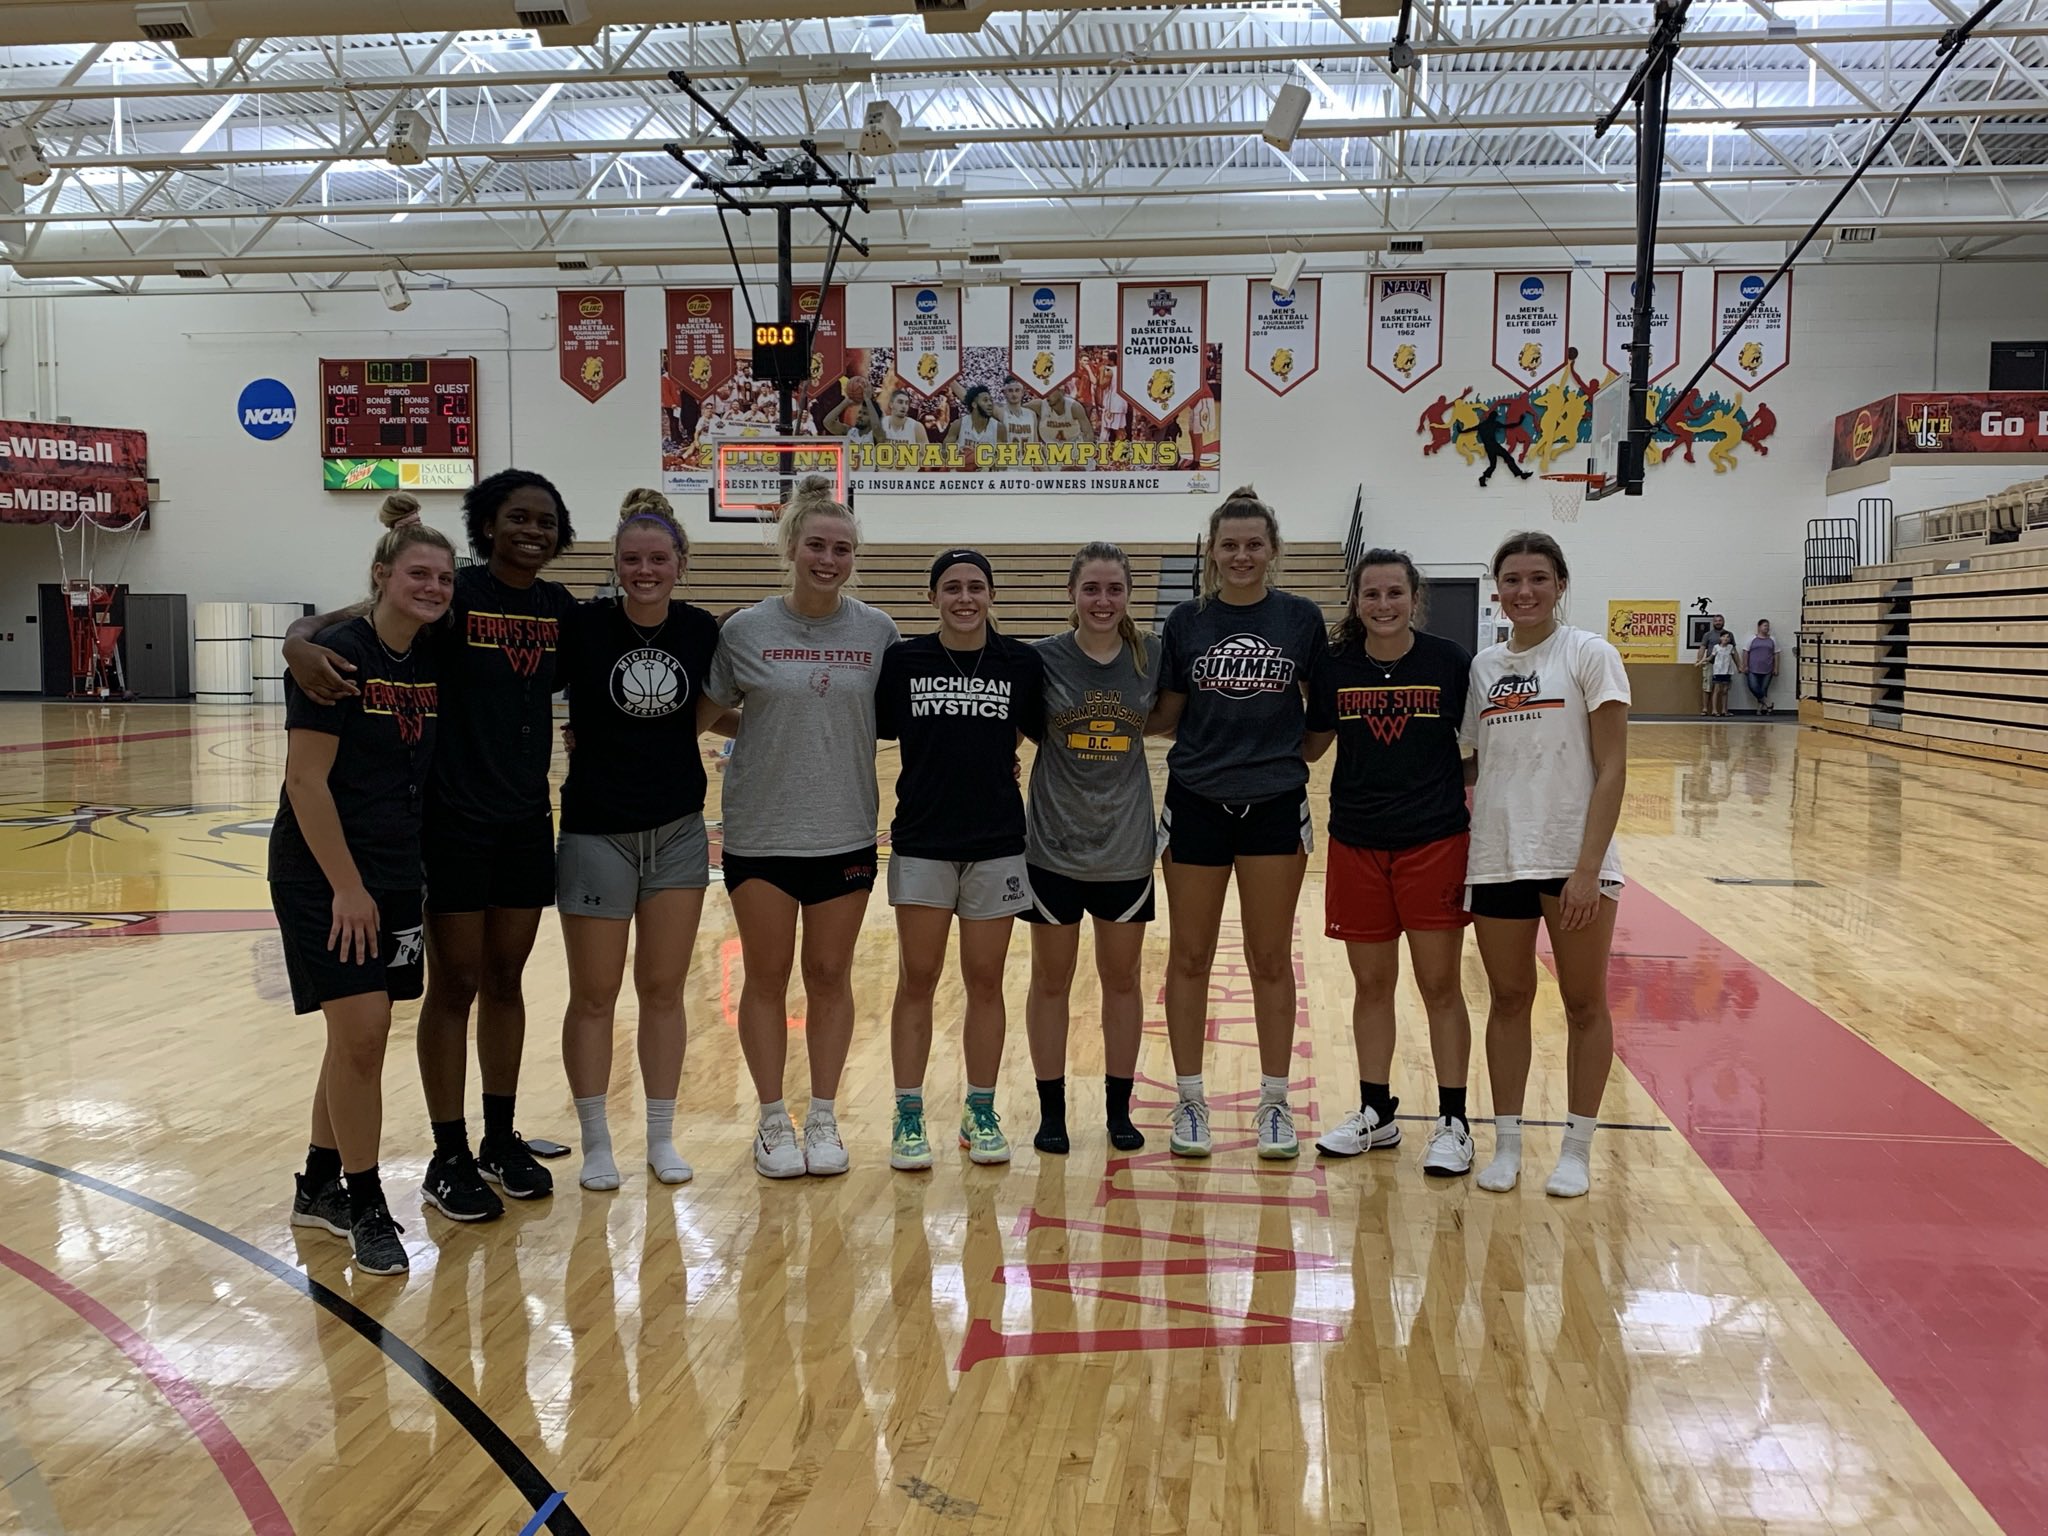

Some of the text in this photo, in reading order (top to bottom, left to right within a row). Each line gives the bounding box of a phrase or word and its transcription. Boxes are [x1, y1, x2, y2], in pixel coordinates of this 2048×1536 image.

[1383, 280, 1430, 298] NAIA
[757, 327, 793, 345] 00.0
[1131, 326, 1193, 334] BASKETBALL
[1124, 345, 1199, 355] CHAMPIONS
[1131, 336, 1193, 346] NATIONAL
[328, 384, 470, 394] HOME GUEST
[335, 396, 358, 416] 20
[444, 396, 466, 416] 20
[244, 408, 294, 426] NCAA
[1908, 418, 1950, 433] WITH
[1981, 412, 2025, 436] Go
[335, 426, 346, 445] 0
[456, 425, 468, 444] 0
[700, 444, 779, 466] 2018
[976, 442, 1178, 468] CHAMPINS
[422, 464, 472, 474] ISABELLA
[422, 475, 454, 484] BANK
[718, 480, 780, 490] PRESENTED
[869, 480, 934, 490] INSURANCE
[939, 480, 984, 490] AGENCY
[988, 480, 996, 490] &
[1000, 480, 1086, 489] AUTO-OWNERS
[1091, 479, 1160, 489] INSURANCE
[1632, 613, 1676, 624] SPORTS
[466, 616, 523, 641] FERRIS
[1631, 625, 1674, 636] CAMPS
[618, 651, 680, 672] MICHIGAN
[762, 649, 872, 664] FERRIS STATE
[1192, 656, 1294, 682] SUMMER
[910, 676, 1012, 696] MICHIGAN
[1488, 680, 1538, 698] USJN
[912, 693, 1010, 704] BASKETBALL
[1084, 690, 1121, 704] USJN
[1337, 690, 1440, 710] FERRIS STATE
[623, 701, 678, 716] MYSTICS
[912, 700, 1008, 720] MYSTICS
[1055, 704, 1144, 730] CHAMPIONSHIP
[1088, 736, 1112, 750] D.C.
[1078, 753, 1118, 762] BASKETBALL
[954, 1072, 1344, 1372] WINK
